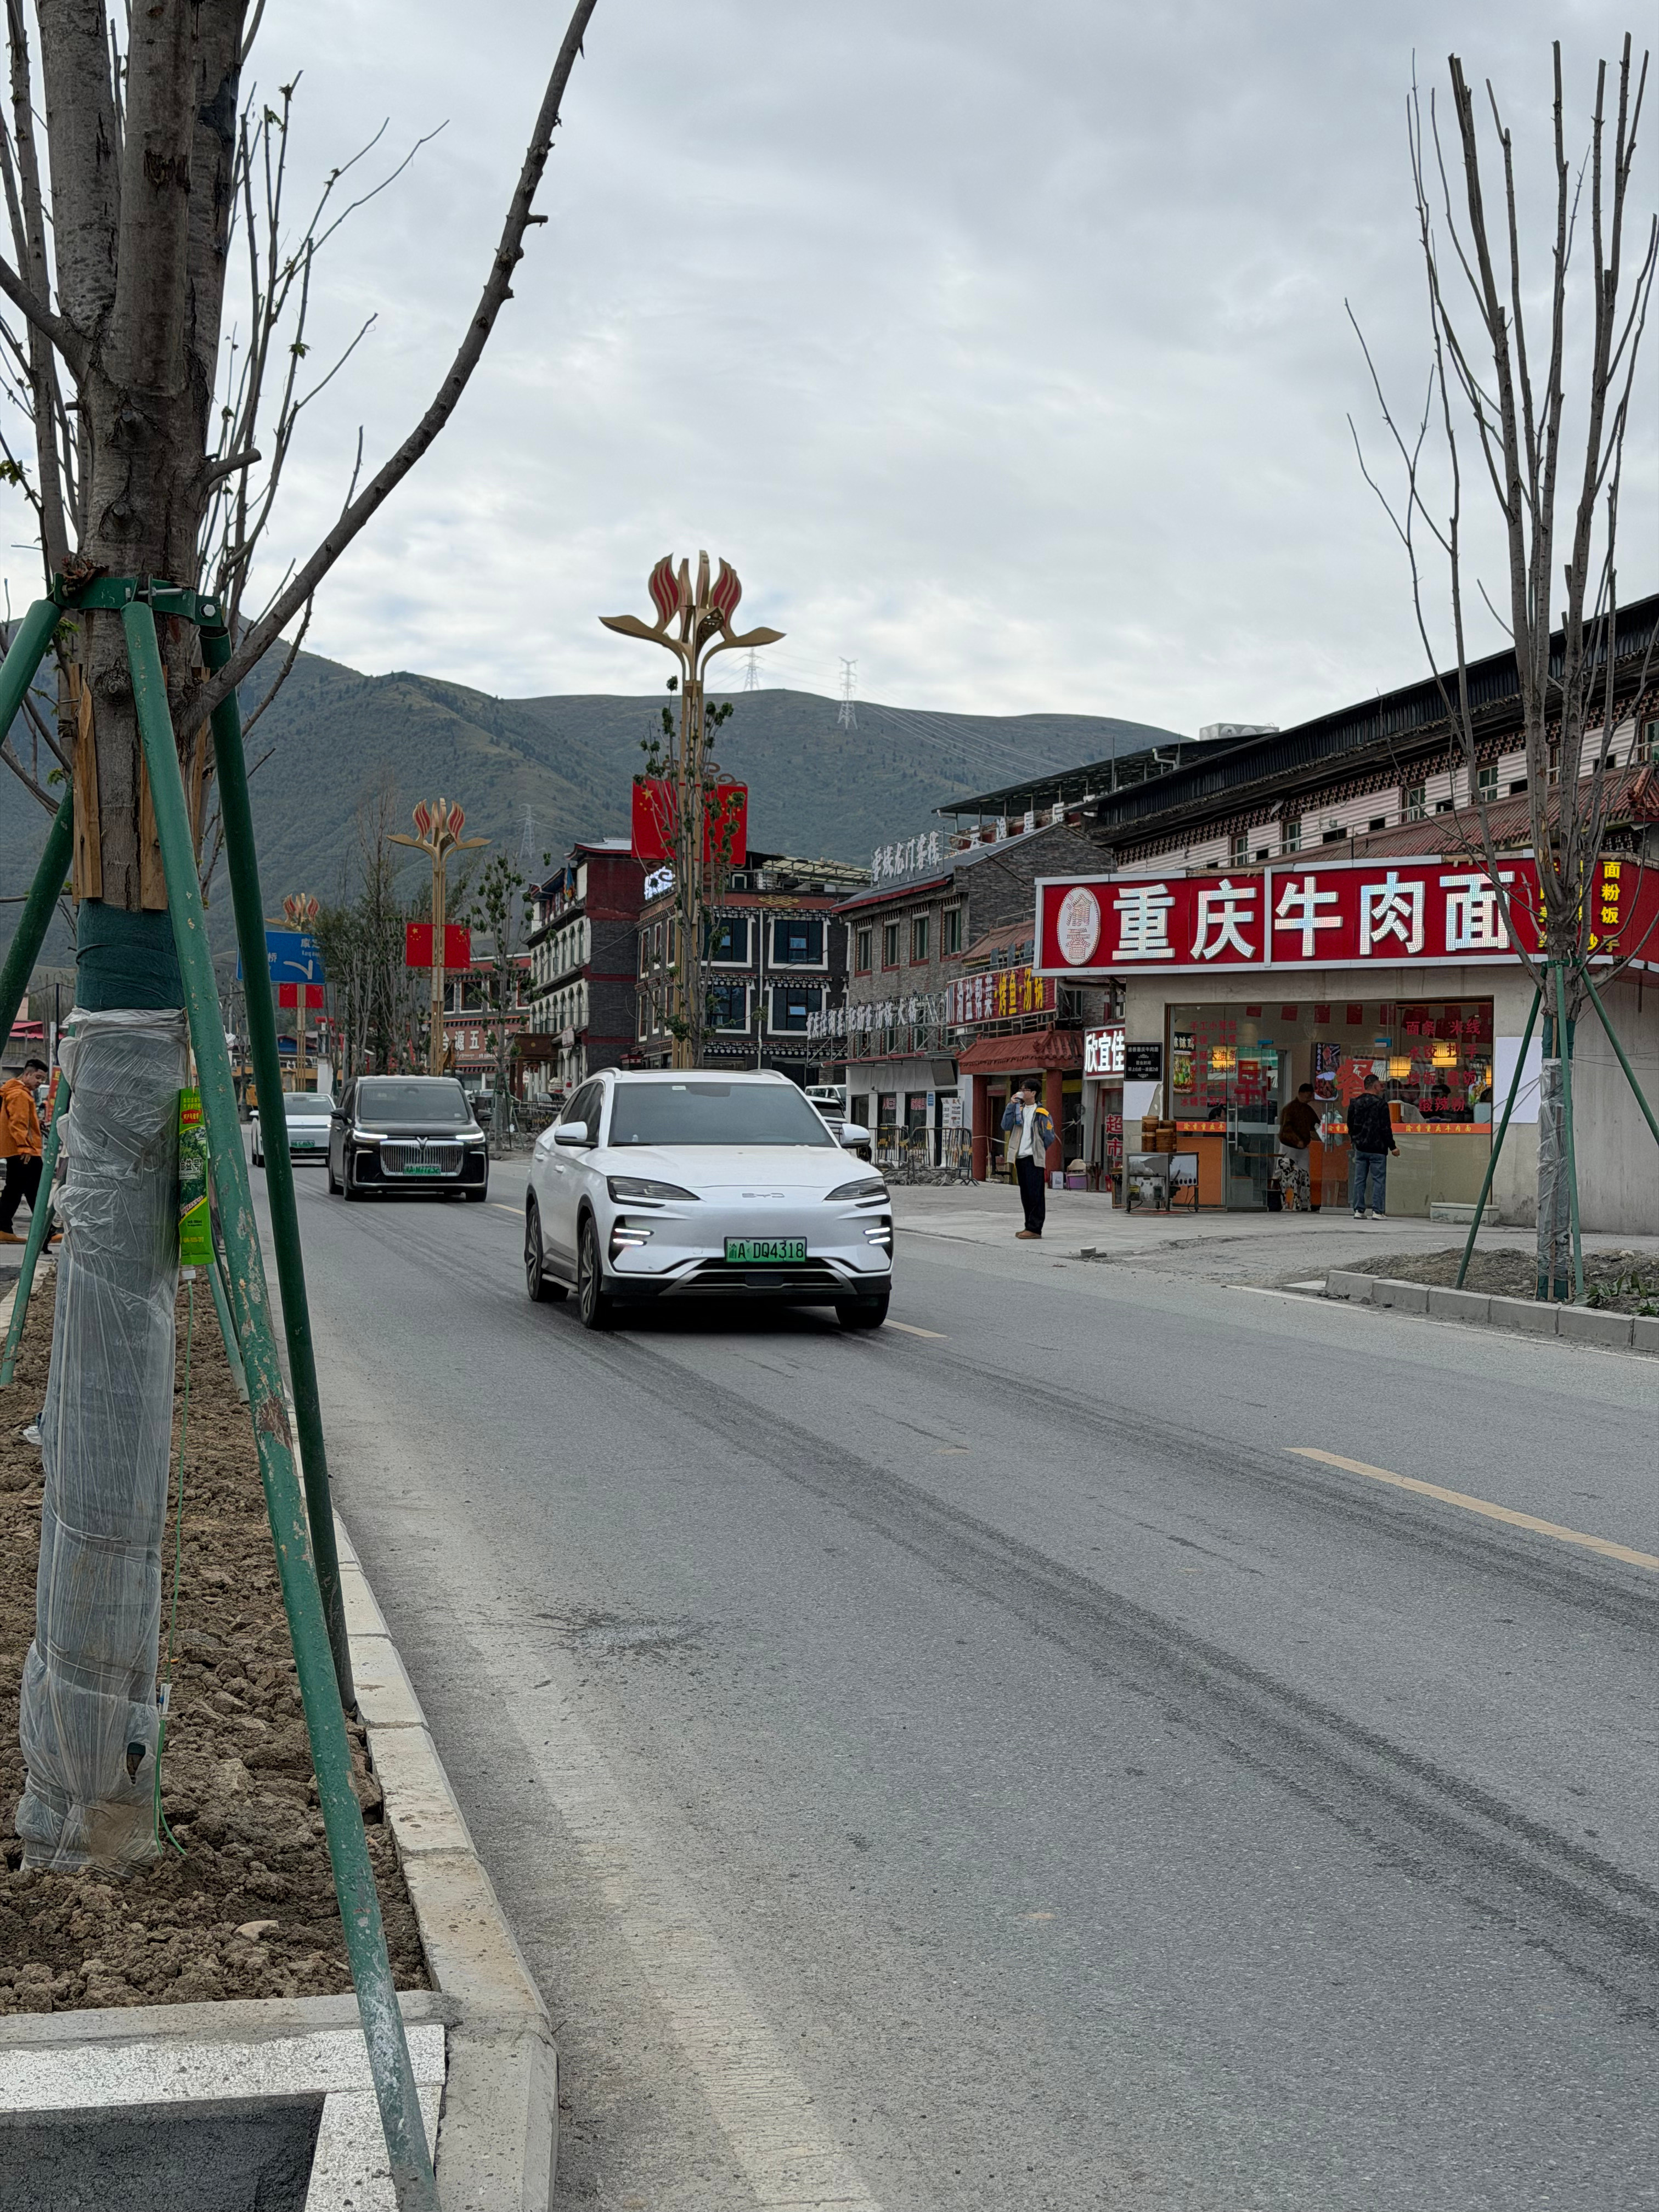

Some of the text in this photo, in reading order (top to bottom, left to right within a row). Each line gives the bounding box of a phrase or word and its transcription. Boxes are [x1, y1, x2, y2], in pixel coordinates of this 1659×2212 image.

[1112, 871, 1515, 960] 重庆牛肉面
[1451, 1018, 1480, 1035] 米线
[1085, 1030, 1125, 1073] 欣宜佳
[1105, 1114, 1123, 1157] 超市
